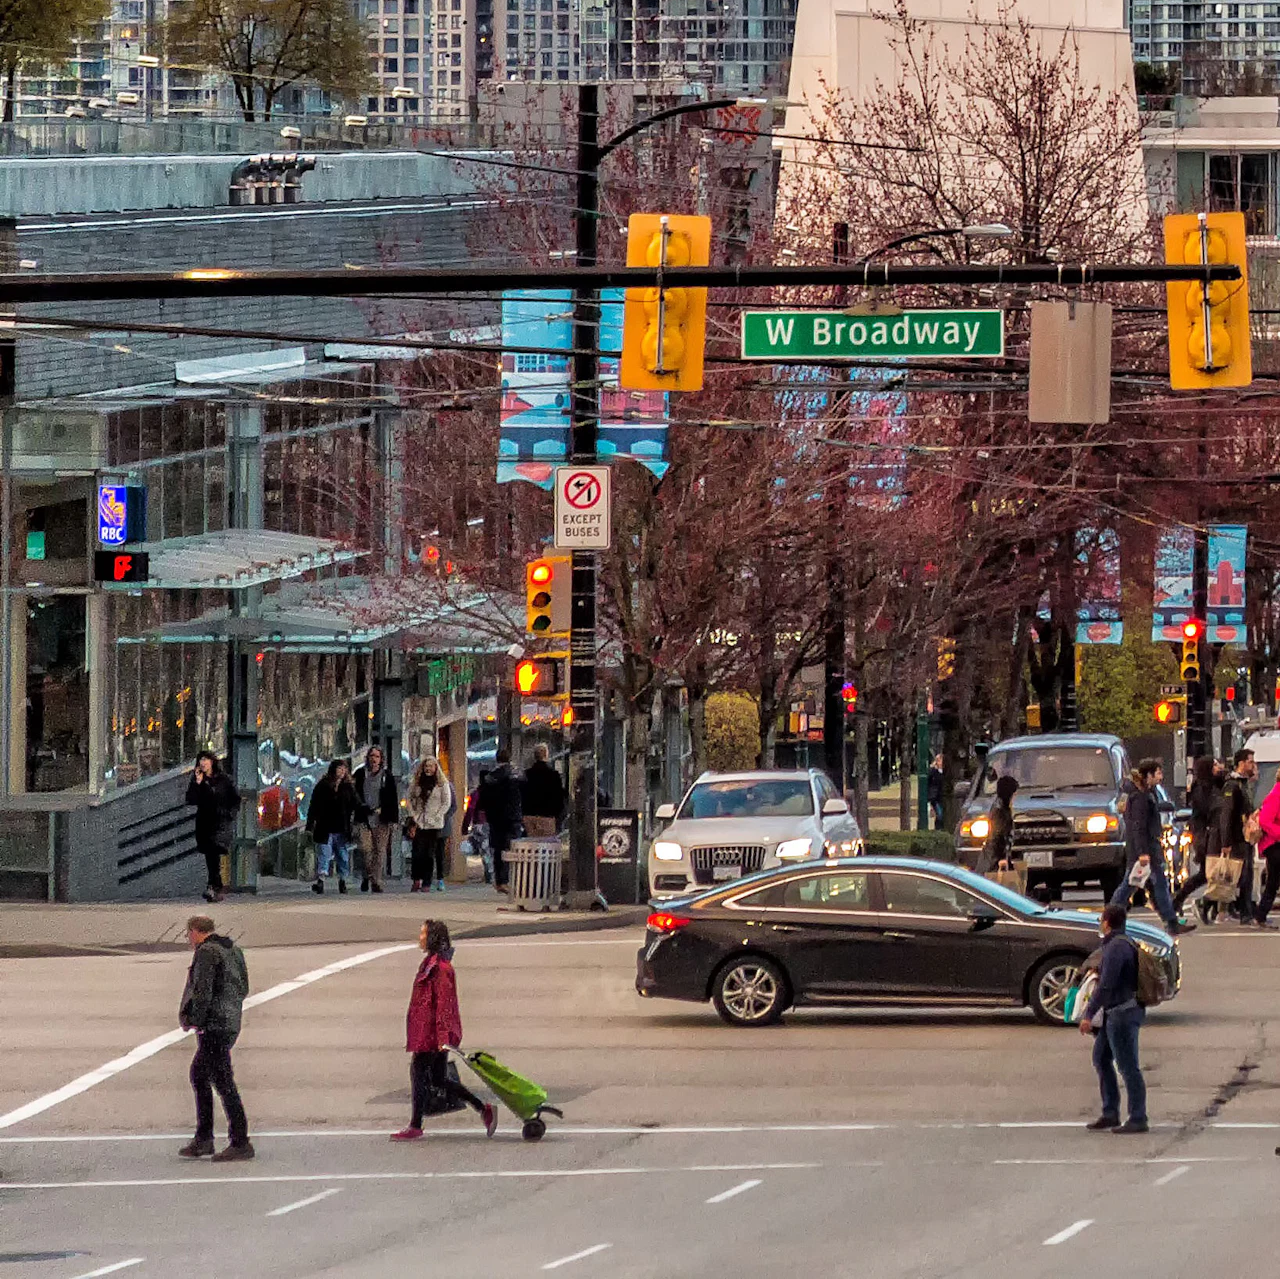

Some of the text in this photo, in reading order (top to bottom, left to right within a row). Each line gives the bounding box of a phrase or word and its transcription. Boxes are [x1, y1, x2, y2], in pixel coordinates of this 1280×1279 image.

[765, 316, 980, 352] W Broadway
[563, 514, 602, 525] EXCEPT
[101, 526, 123, 540] RBC
[565, 527, 600, 537] BUSES
